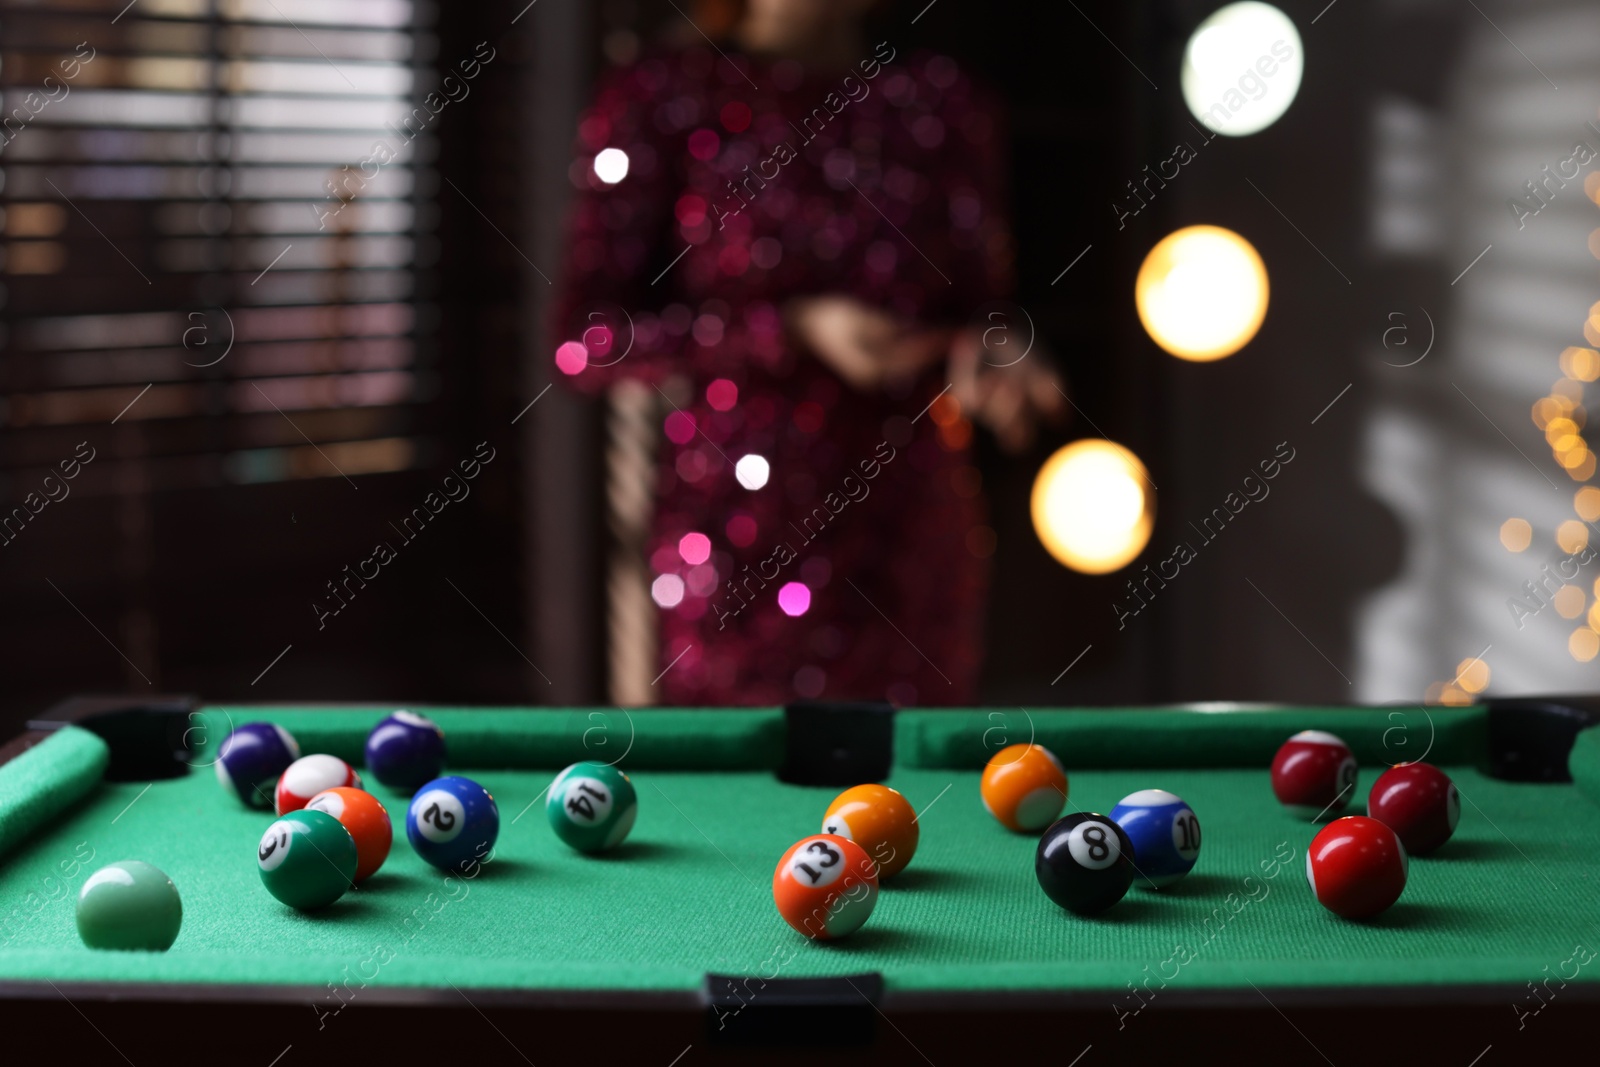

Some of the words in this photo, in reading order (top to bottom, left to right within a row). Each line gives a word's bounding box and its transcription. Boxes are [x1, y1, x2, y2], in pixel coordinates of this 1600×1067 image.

[423, 802, 455, 832] 2
[567, 782, 606, 822] 14
[1083, 826, 1109, 861] 8
[1177, 815, 1200, 851] 10
[795, 841, 840, 884] 13
